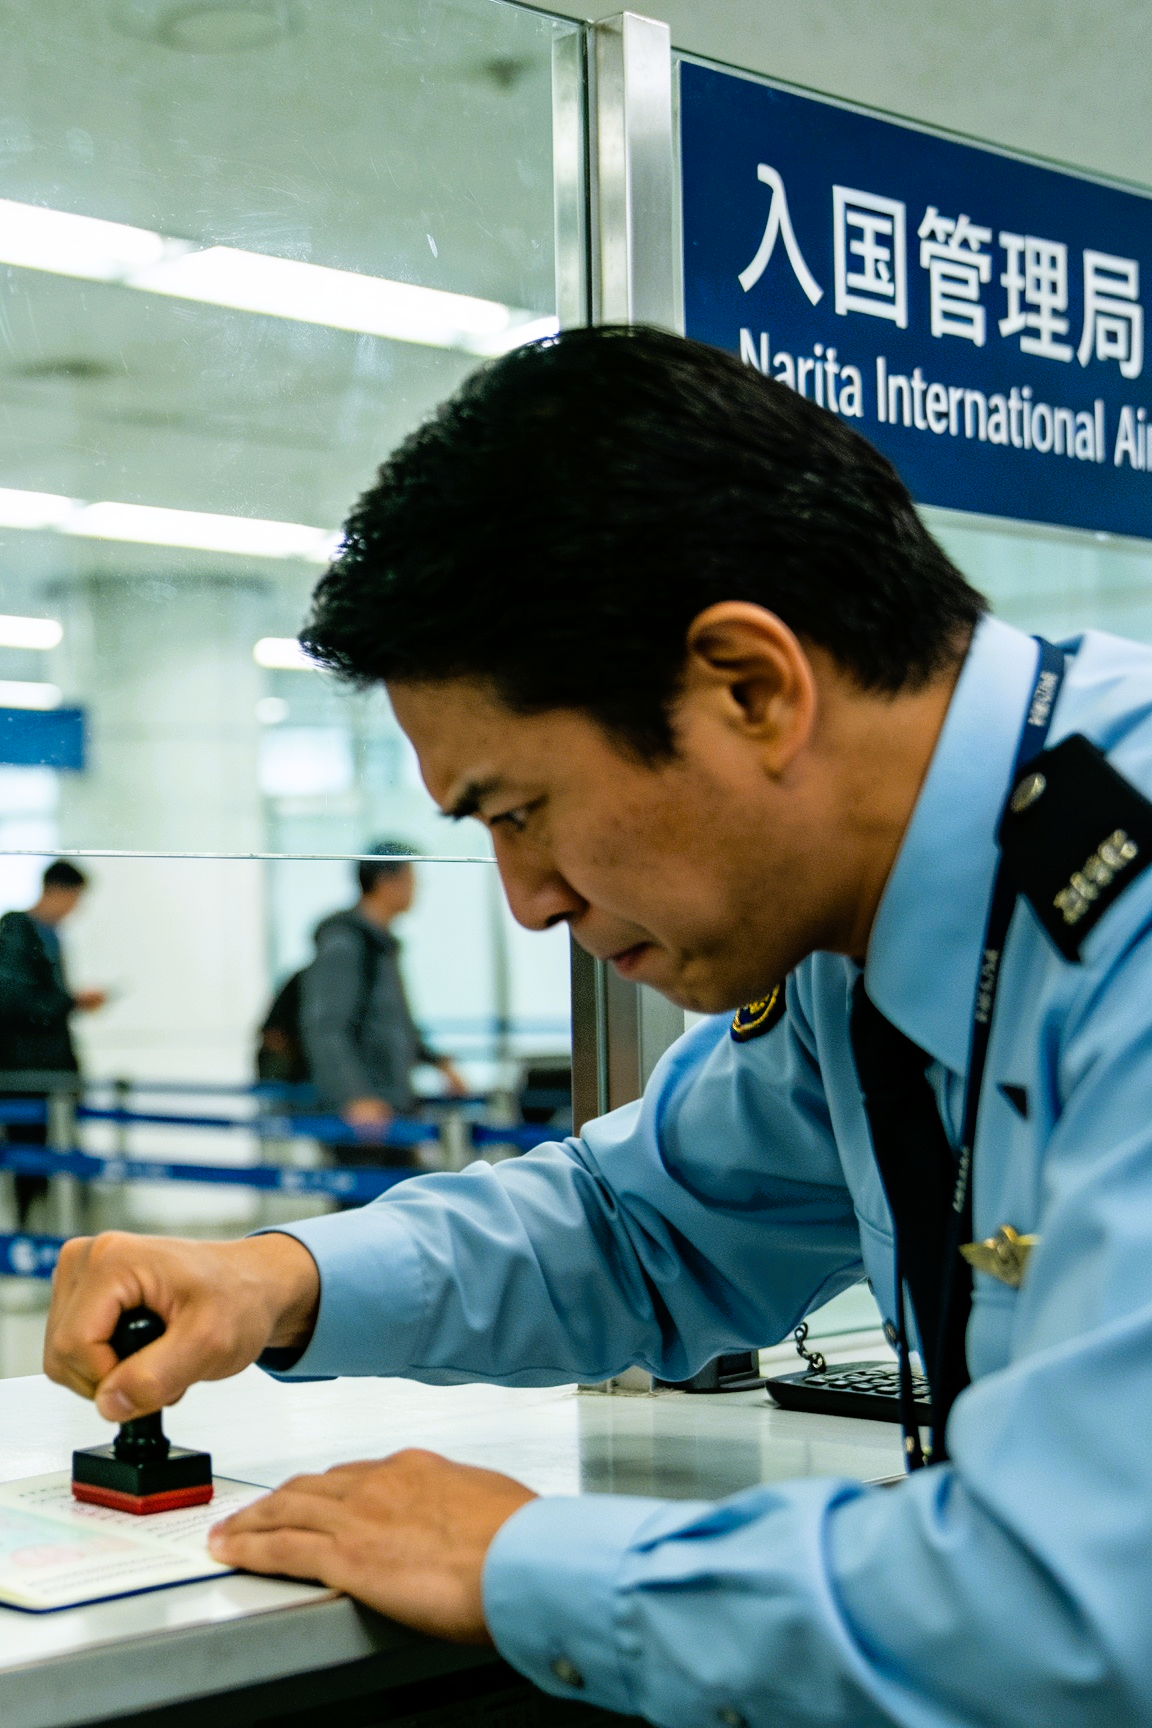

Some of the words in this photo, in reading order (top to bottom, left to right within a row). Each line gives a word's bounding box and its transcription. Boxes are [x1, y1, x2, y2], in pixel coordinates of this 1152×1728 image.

[737, 163, 1145, 380] 入国管理局
[876, 356, 1105, 463] International
